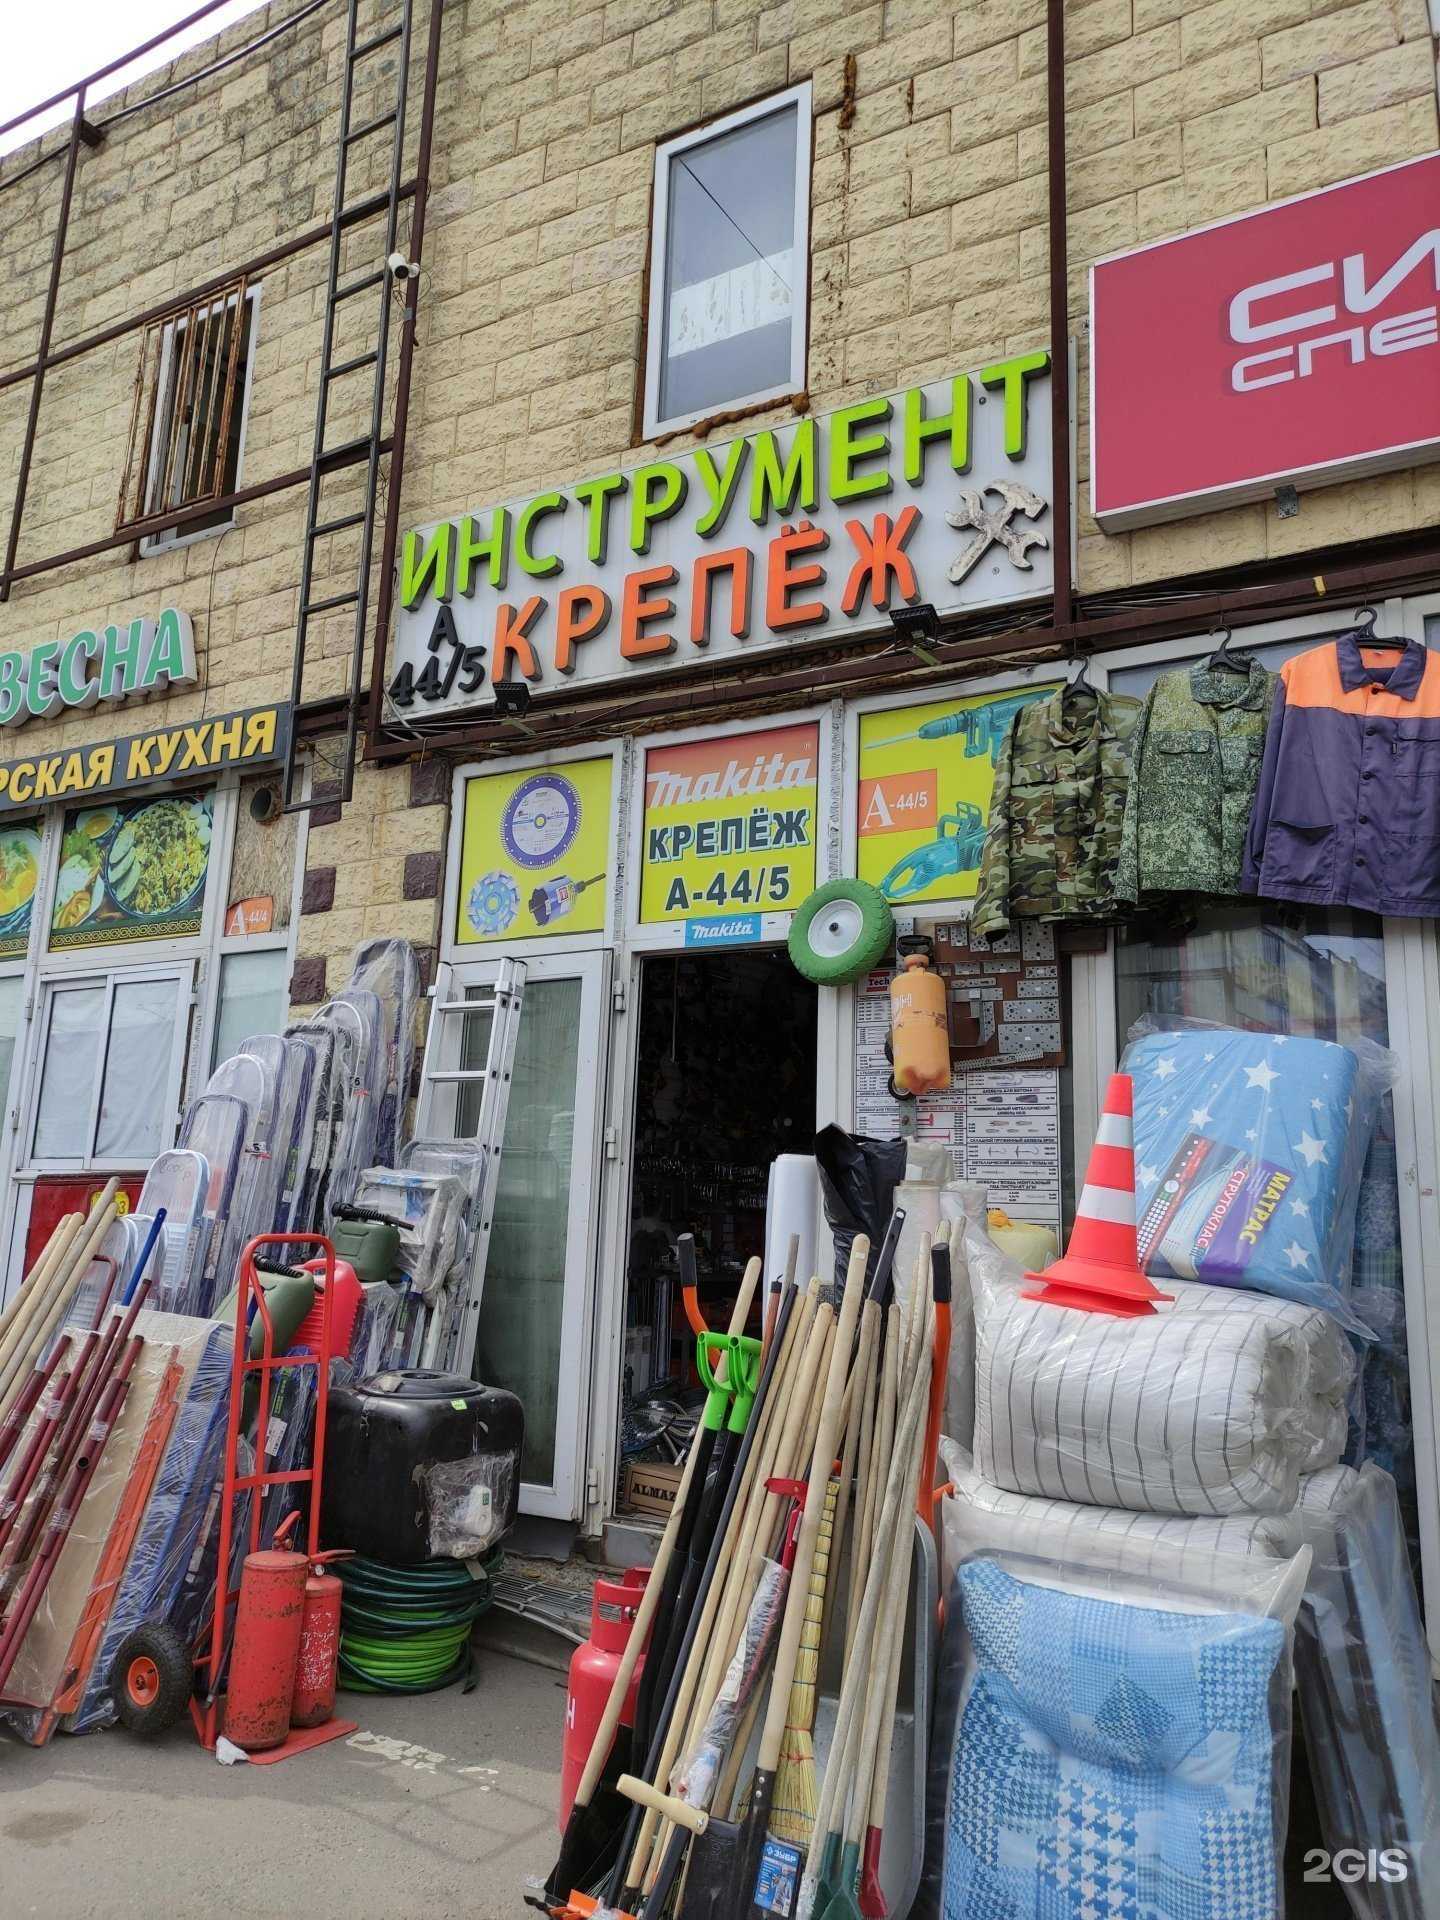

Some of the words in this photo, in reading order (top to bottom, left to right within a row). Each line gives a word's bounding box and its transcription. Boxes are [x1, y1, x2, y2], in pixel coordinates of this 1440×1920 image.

[1232, 306, 1439, 392] СПЕ
[402, 350, 1052, 611] ИНСТРУМЕНТ
[427, 605, 458, 652] А
[492, 506, 923, 683] КРЕПЁЖ
[0, 608, 196, 727] ВЕСНА
[387, 642, 486, 706] 44/5
[126, 710, 277, 780] КУХНЯ
[648, 807, 811, 864] КРЕПЁЖ
[664, 866, 791, 912] А-44/5
[1239, 1171, 1291, 1245] МАТРАС
